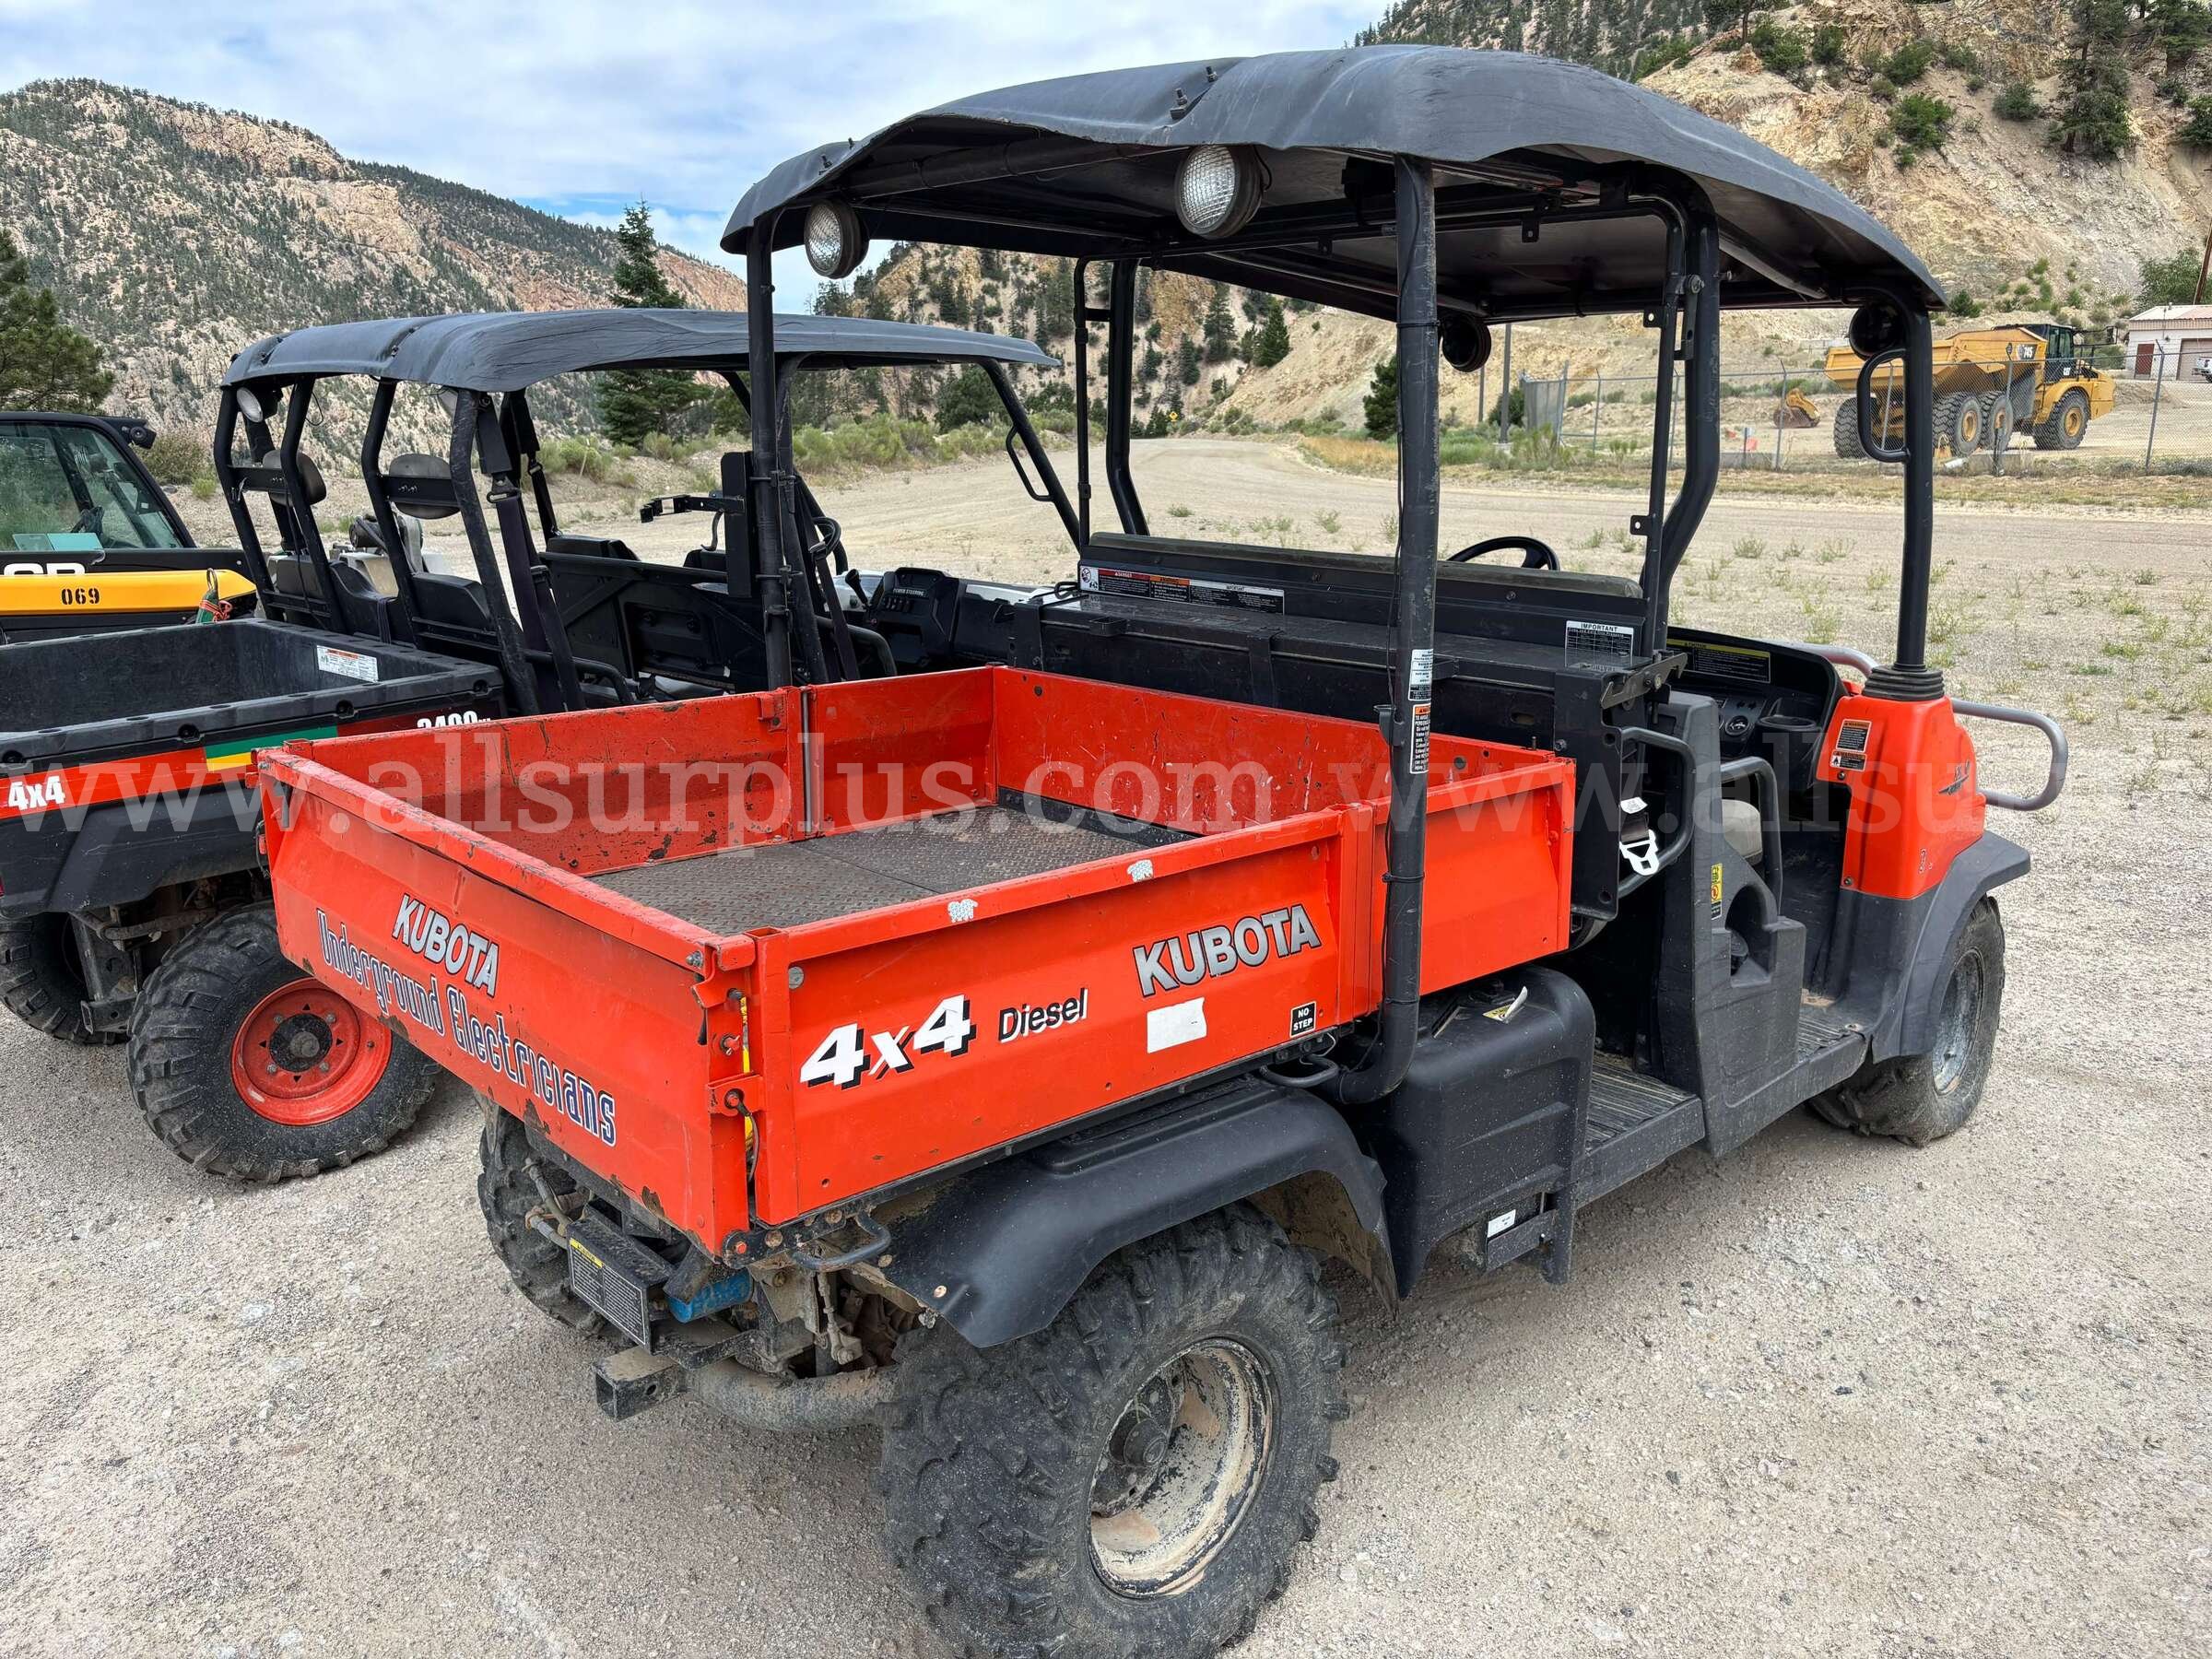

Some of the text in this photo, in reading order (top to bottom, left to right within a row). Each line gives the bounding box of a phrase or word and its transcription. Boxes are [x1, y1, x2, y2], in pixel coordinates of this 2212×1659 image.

[62, 587, 100, 606] 069
[1581, 622, 1618, 633] IMPORTANT
[7, 775, 66, 811] 4x4
[392, 893, 500, 997] KUBOTA
[1132, 903, 1322, 997] KUBOTA
[317, 909, 617, 1147] Underground Electricians
[1293, 1018, 1313, 1031] STEP
[1298, 1007, 1310, 1018] NO
[800, 987, 1088, 1090] 4x4 Diesel
